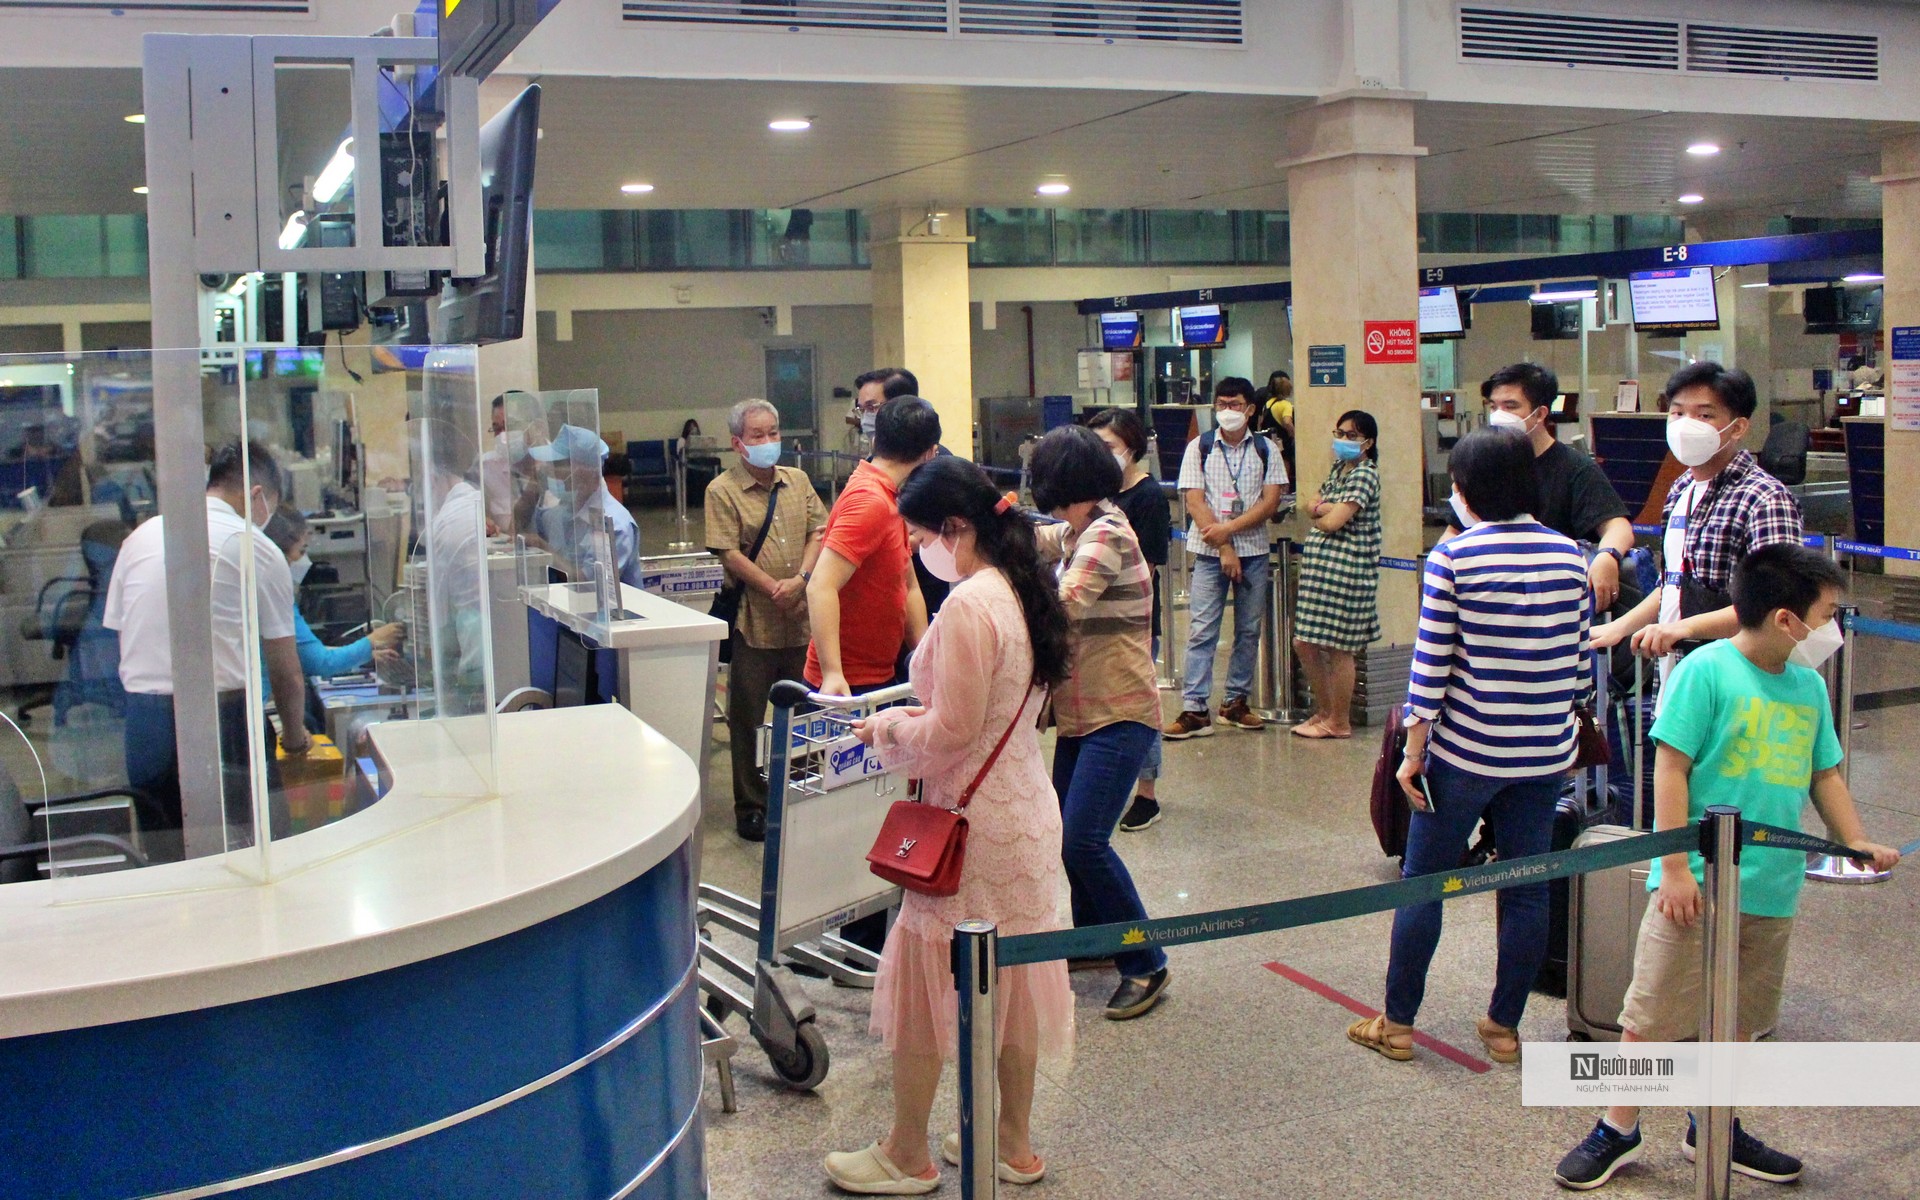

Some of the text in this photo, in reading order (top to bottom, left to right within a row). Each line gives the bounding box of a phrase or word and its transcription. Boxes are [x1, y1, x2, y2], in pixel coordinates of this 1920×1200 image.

[1663, 245, 1688, 262] E-8
[1426, 268, 1444, 282] E-9
[1198, 289, 1213, 301] E-11
[1113, 296, 1128, 308] E-12
[1389, 328, 1411, 337] KHÔNG
